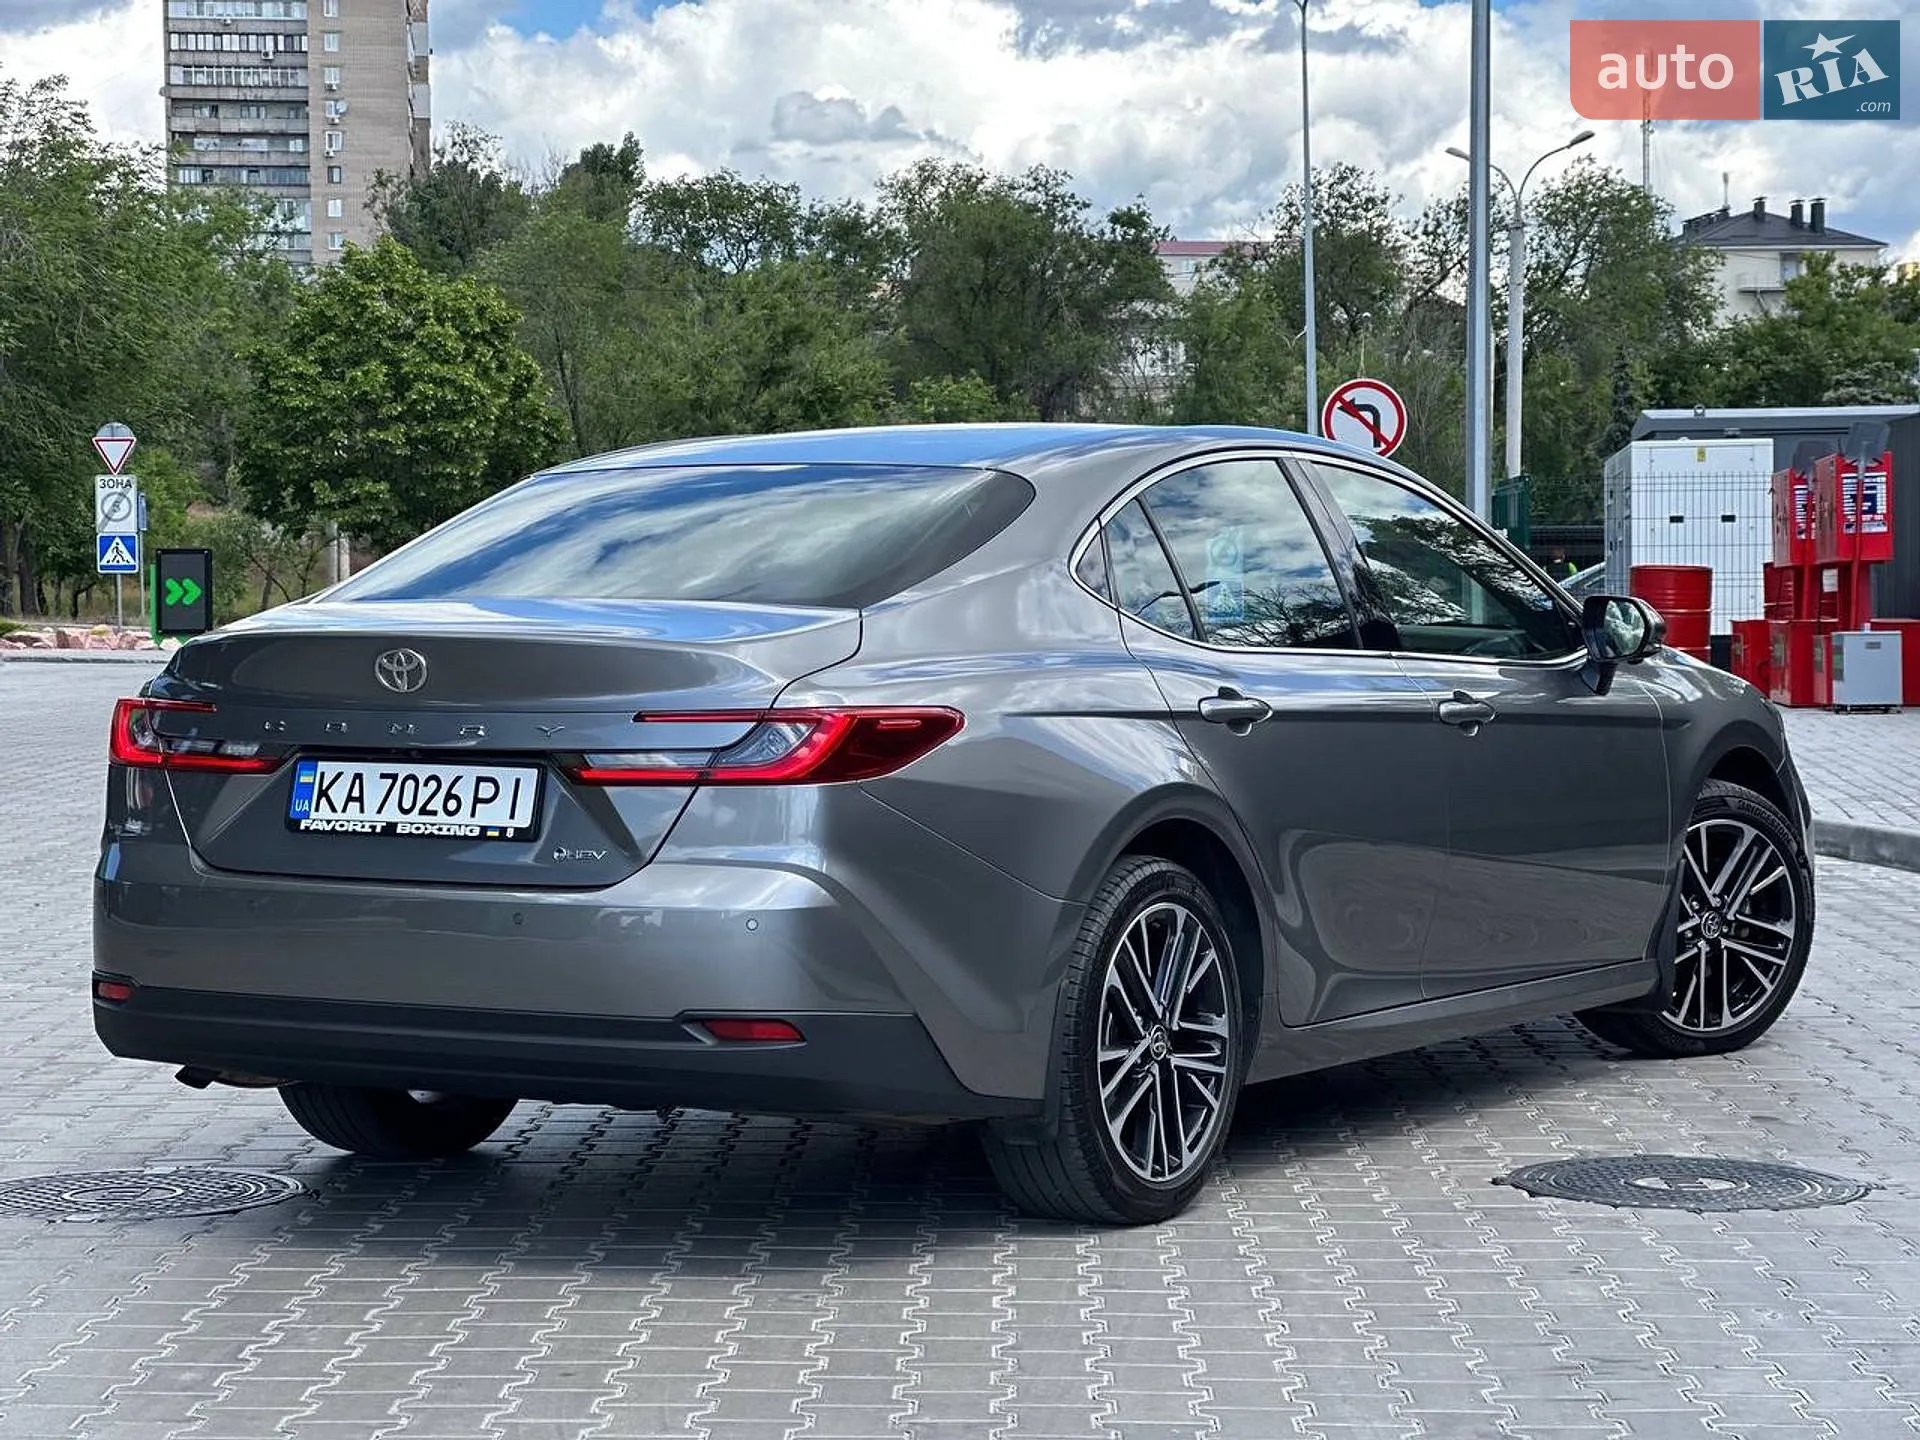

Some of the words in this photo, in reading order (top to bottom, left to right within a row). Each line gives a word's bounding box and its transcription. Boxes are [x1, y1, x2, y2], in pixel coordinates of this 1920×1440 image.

[99, 478, 132, 489] ЗОНА
[376, 772, 464, 817] 7026
[295, 800, 309, 812] UA
[300, 818, 387, 833] FAVORIT
[396, 821, 481, 837] BOXING
